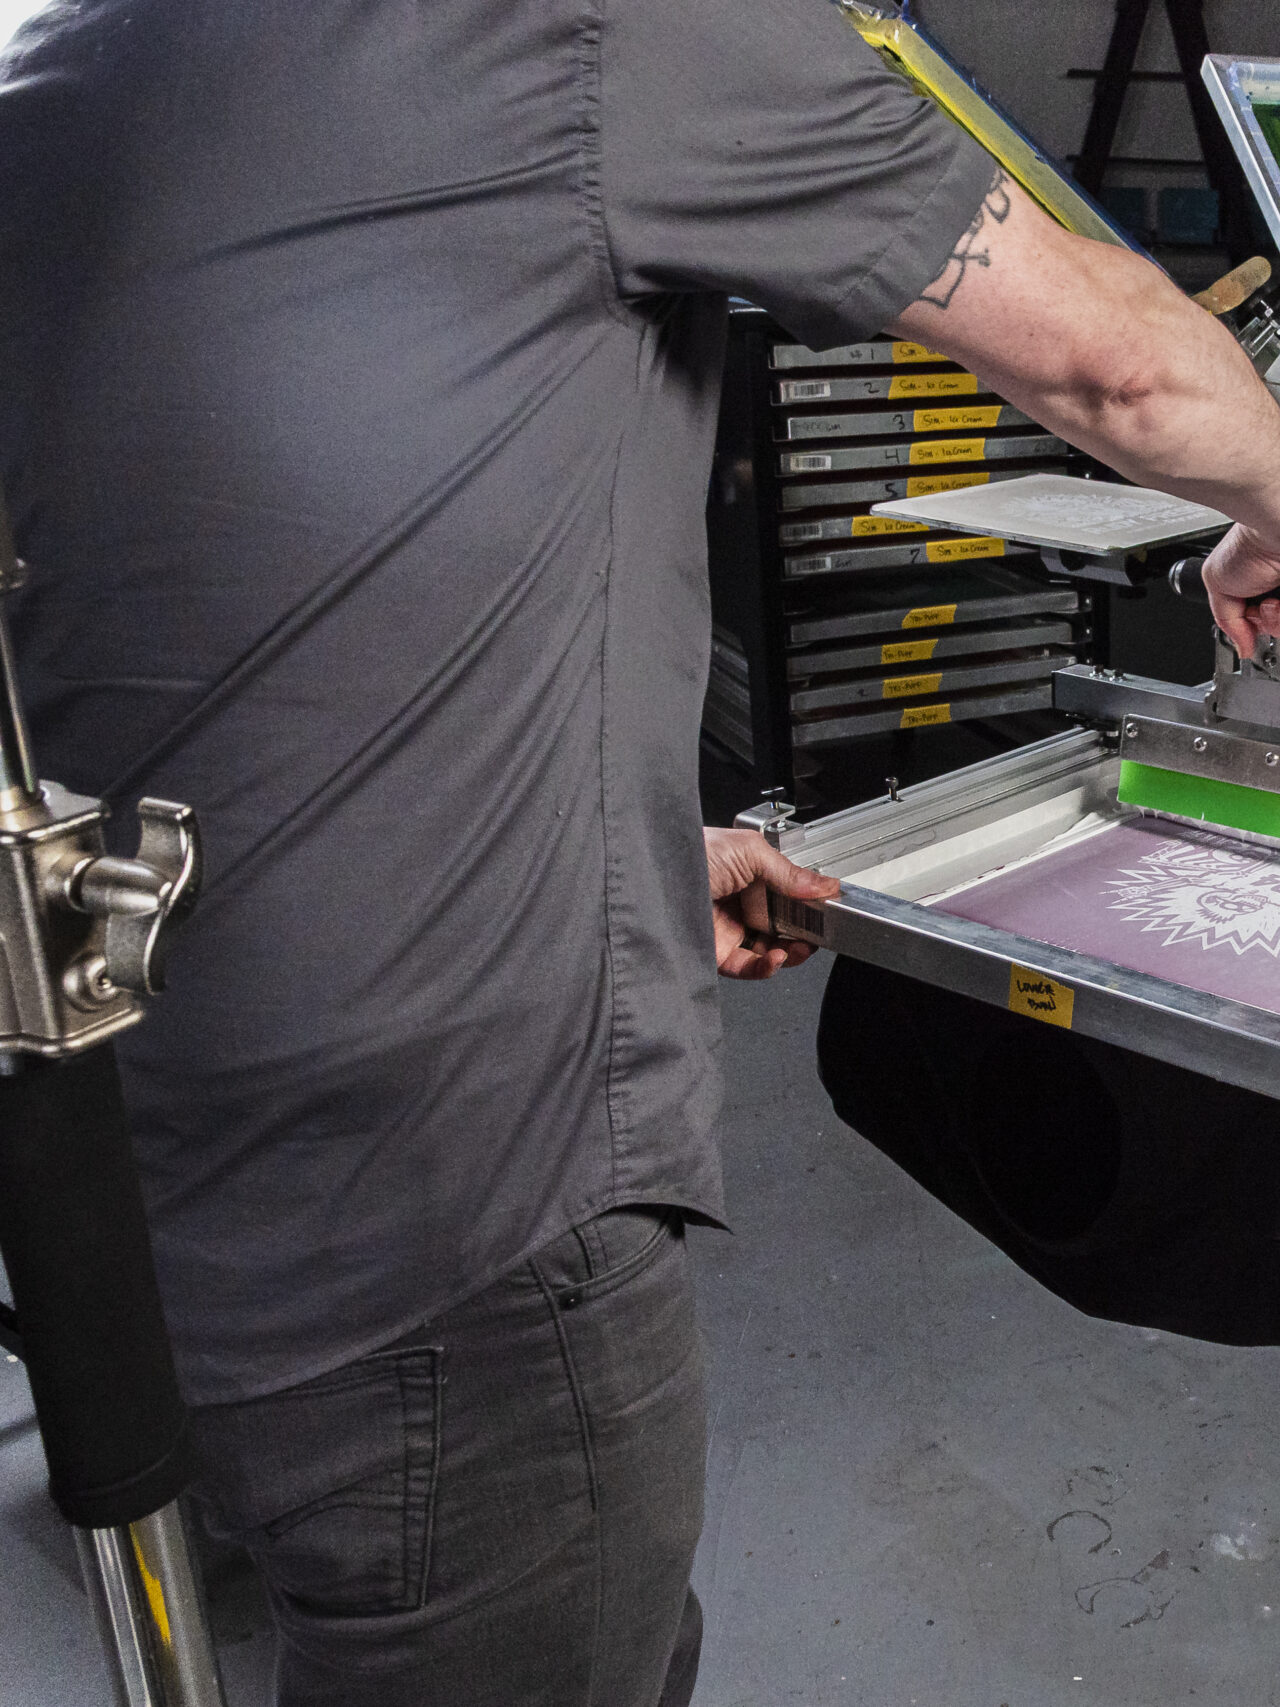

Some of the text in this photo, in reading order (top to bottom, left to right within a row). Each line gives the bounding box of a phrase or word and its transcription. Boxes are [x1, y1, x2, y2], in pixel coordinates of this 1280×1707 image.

[893, 414, 905, 430] 3
[885, 448, 899, 464] 4
[885, 483, 898, 498] 5
[910, 549, 920, 564] 7
